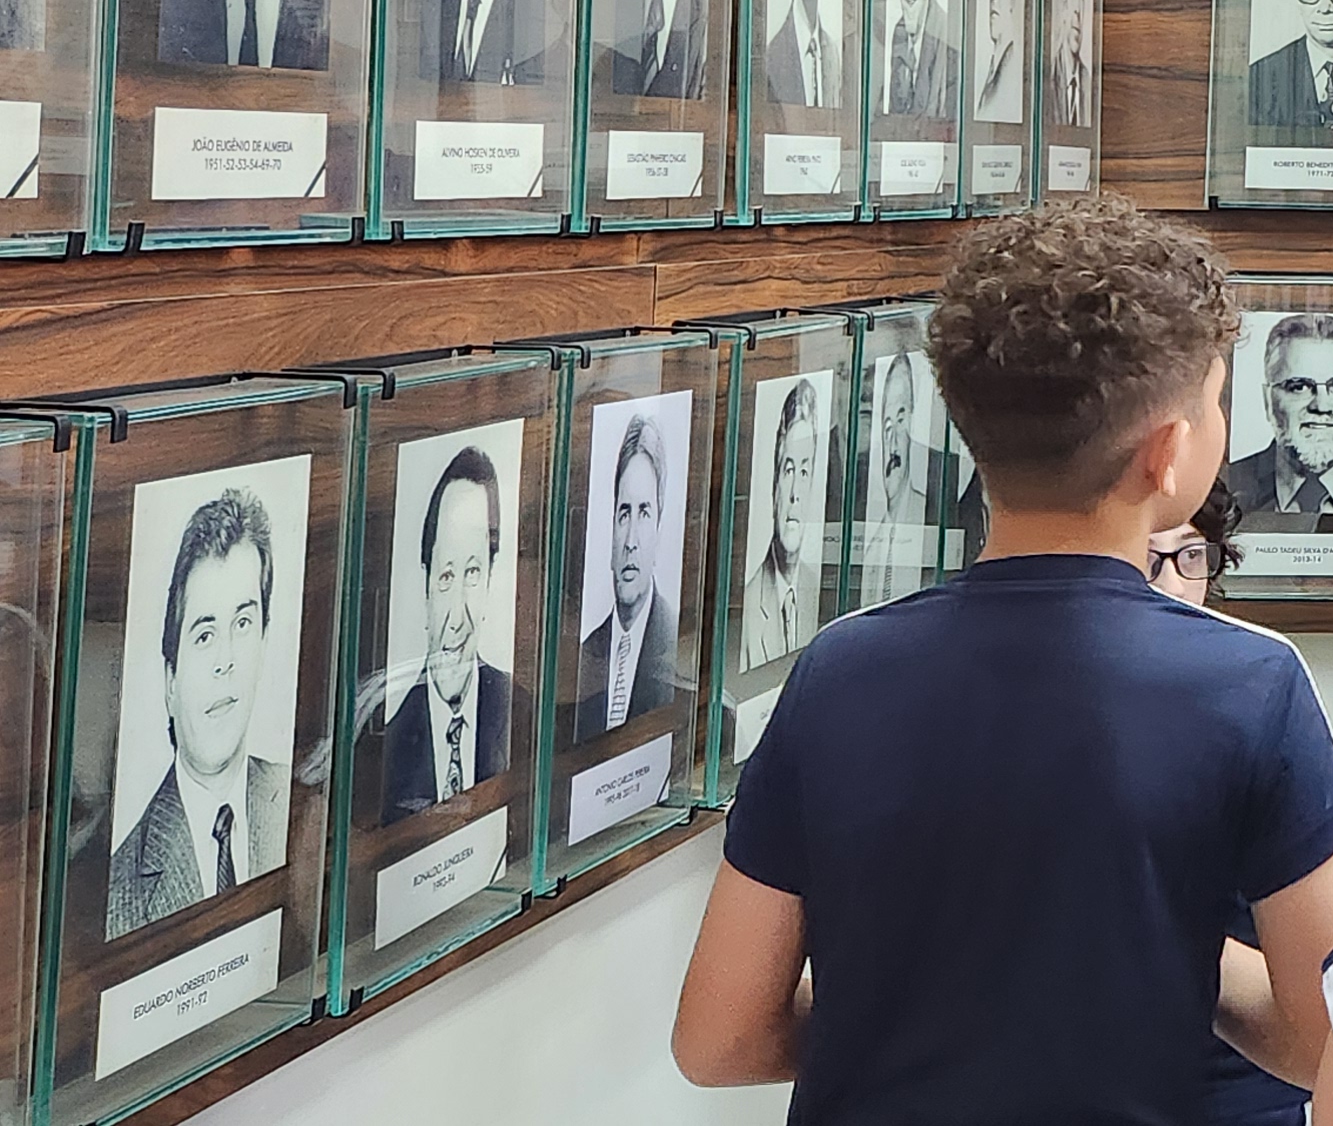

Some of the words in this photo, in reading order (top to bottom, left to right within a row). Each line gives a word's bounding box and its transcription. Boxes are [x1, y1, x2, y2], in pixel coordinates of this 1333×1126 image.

[192, 137, 215, 152] JOÃO
[216, 138, 250, 152] EUGÊNIO
[252, 140, 262, 152] DE
[263, 140, 293, 153] ALMEIDA
[489, 148, 496, 158] DE
[204, 158, 282, 171] 1951-52-53-54-69-70
[1273, 161, 1304, 169] ROBERTO
[1256, 546, 1279, 554] PAULO
[1304, 547, 1321, 555] SILVA
[1293, 555, 1322, 563] 2013-14
[132, 988, 174, 1021] EDUARDO
[174, 968, 217, 999] NORBERTO
[216, 953, 250, 980] FERREIRA
[176, 990, 209, 1017] 1991-92
